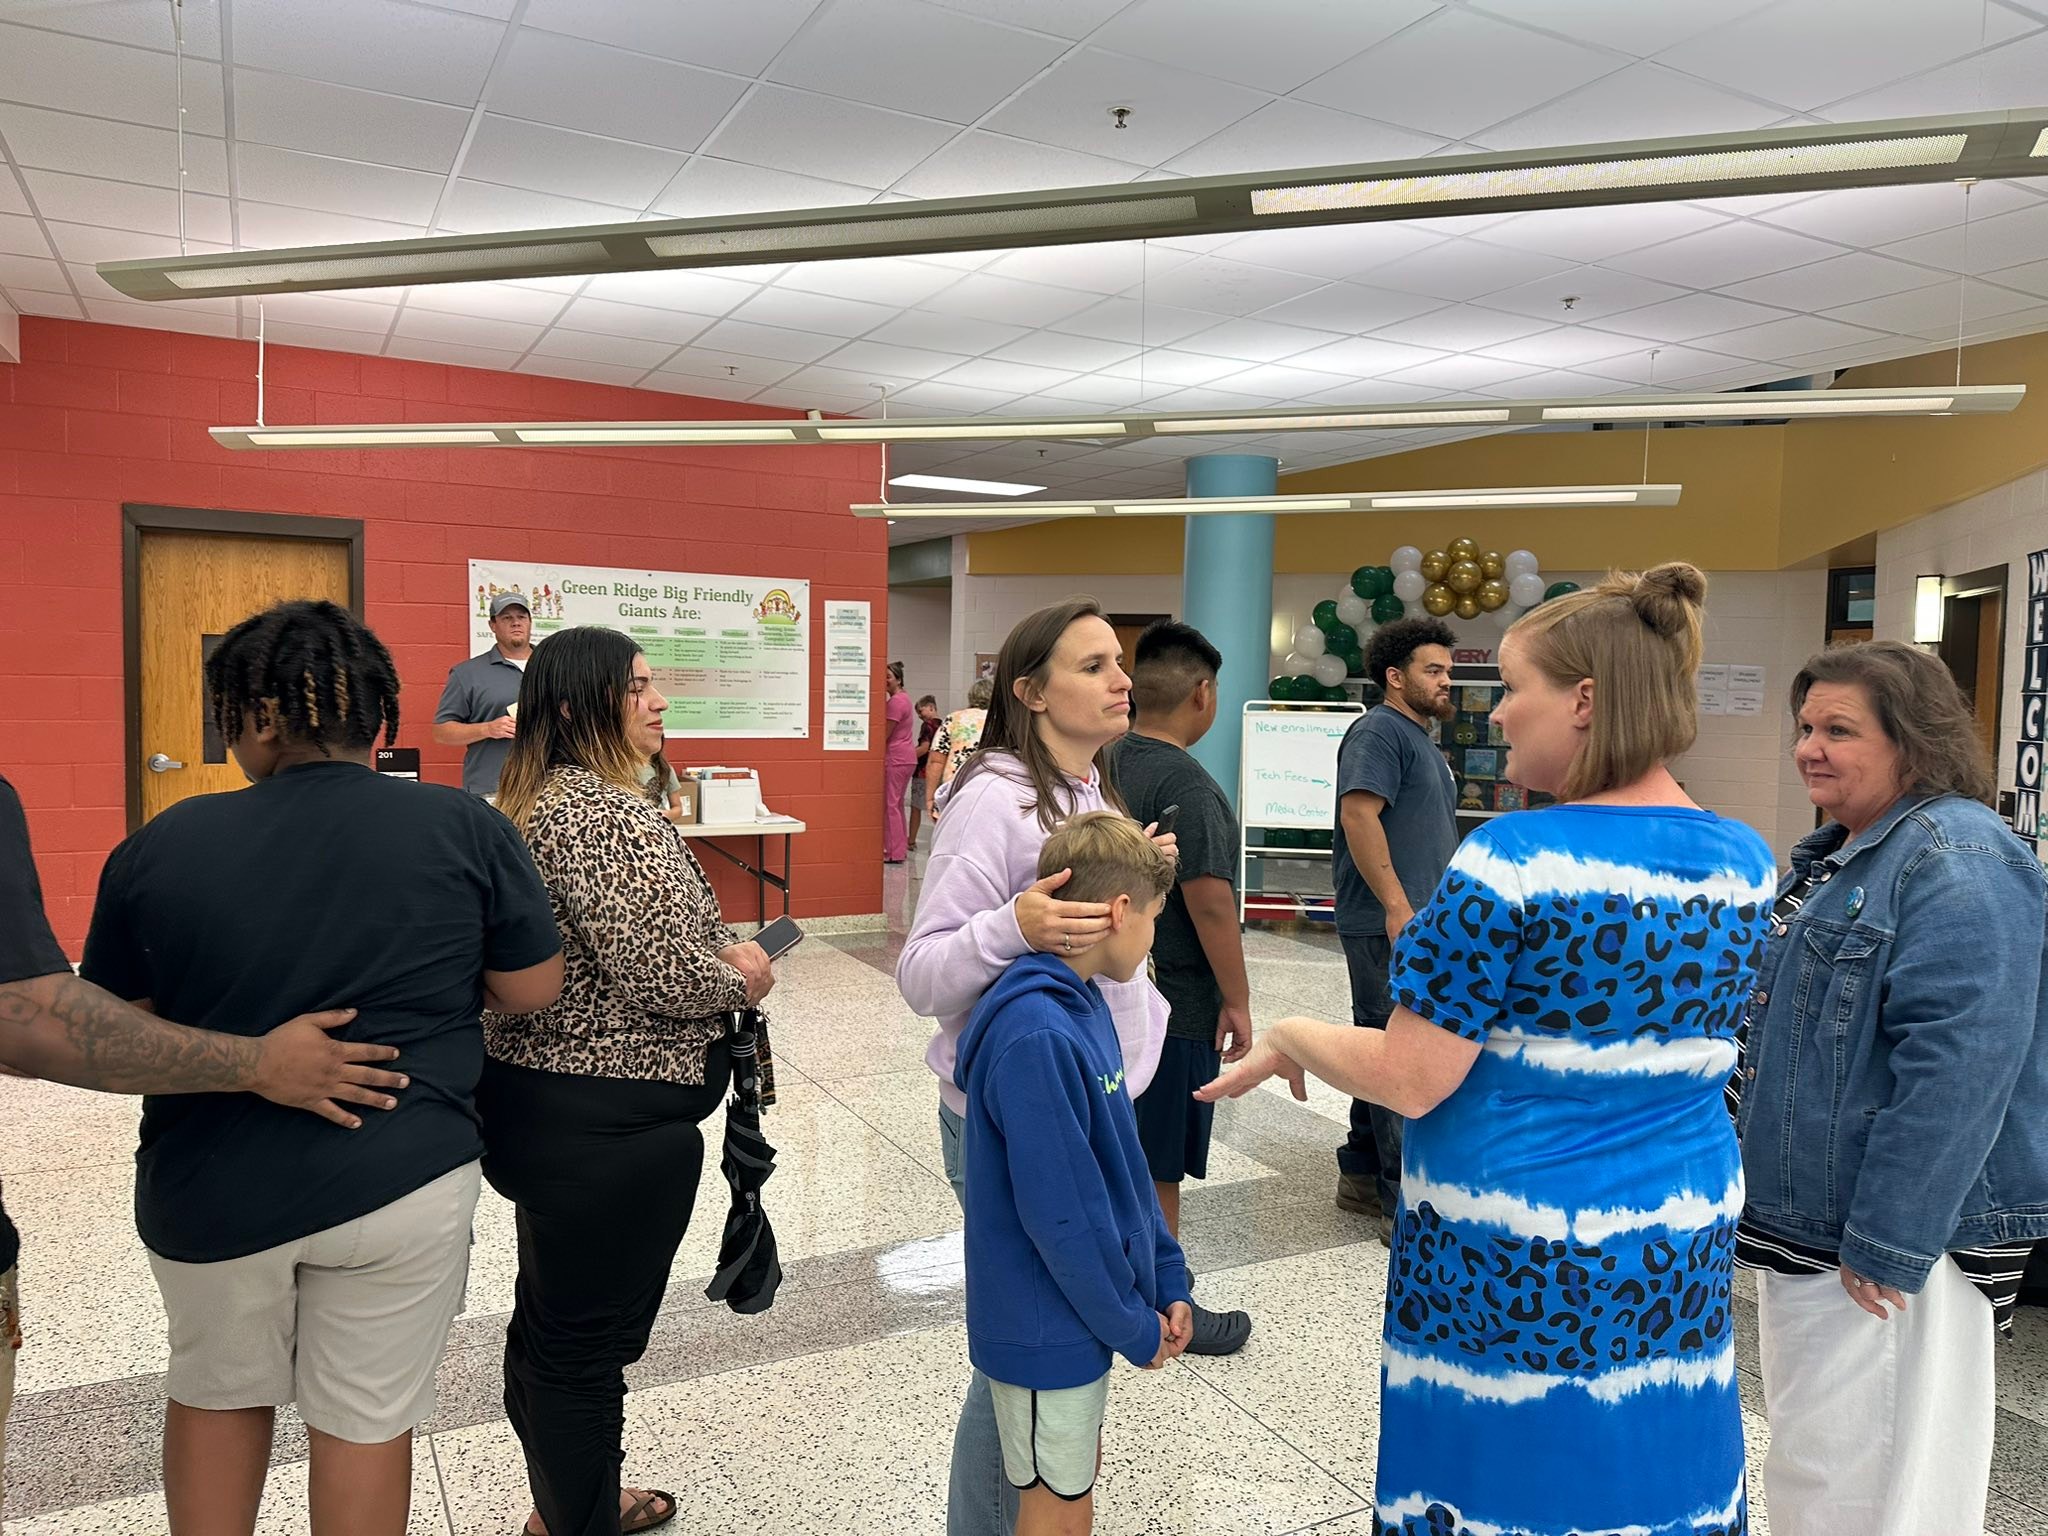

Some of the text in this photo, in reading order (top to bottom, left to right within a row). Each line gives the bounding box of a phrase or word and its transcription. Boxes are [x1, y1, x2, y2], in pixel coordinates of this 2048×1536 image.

[561, 579, 753, 608] Green Ridge Big Friendly
[618, 602, 702, 620] Giants Are:
[2017, 551, 2048, 849] WELCOM
[1255, 721, 1278, 734] New
[377, 751, 394, 759] 201
[1254, 769, 1310, 783] Tech Fees
[1265, 801, 1329, 818] Media Center
